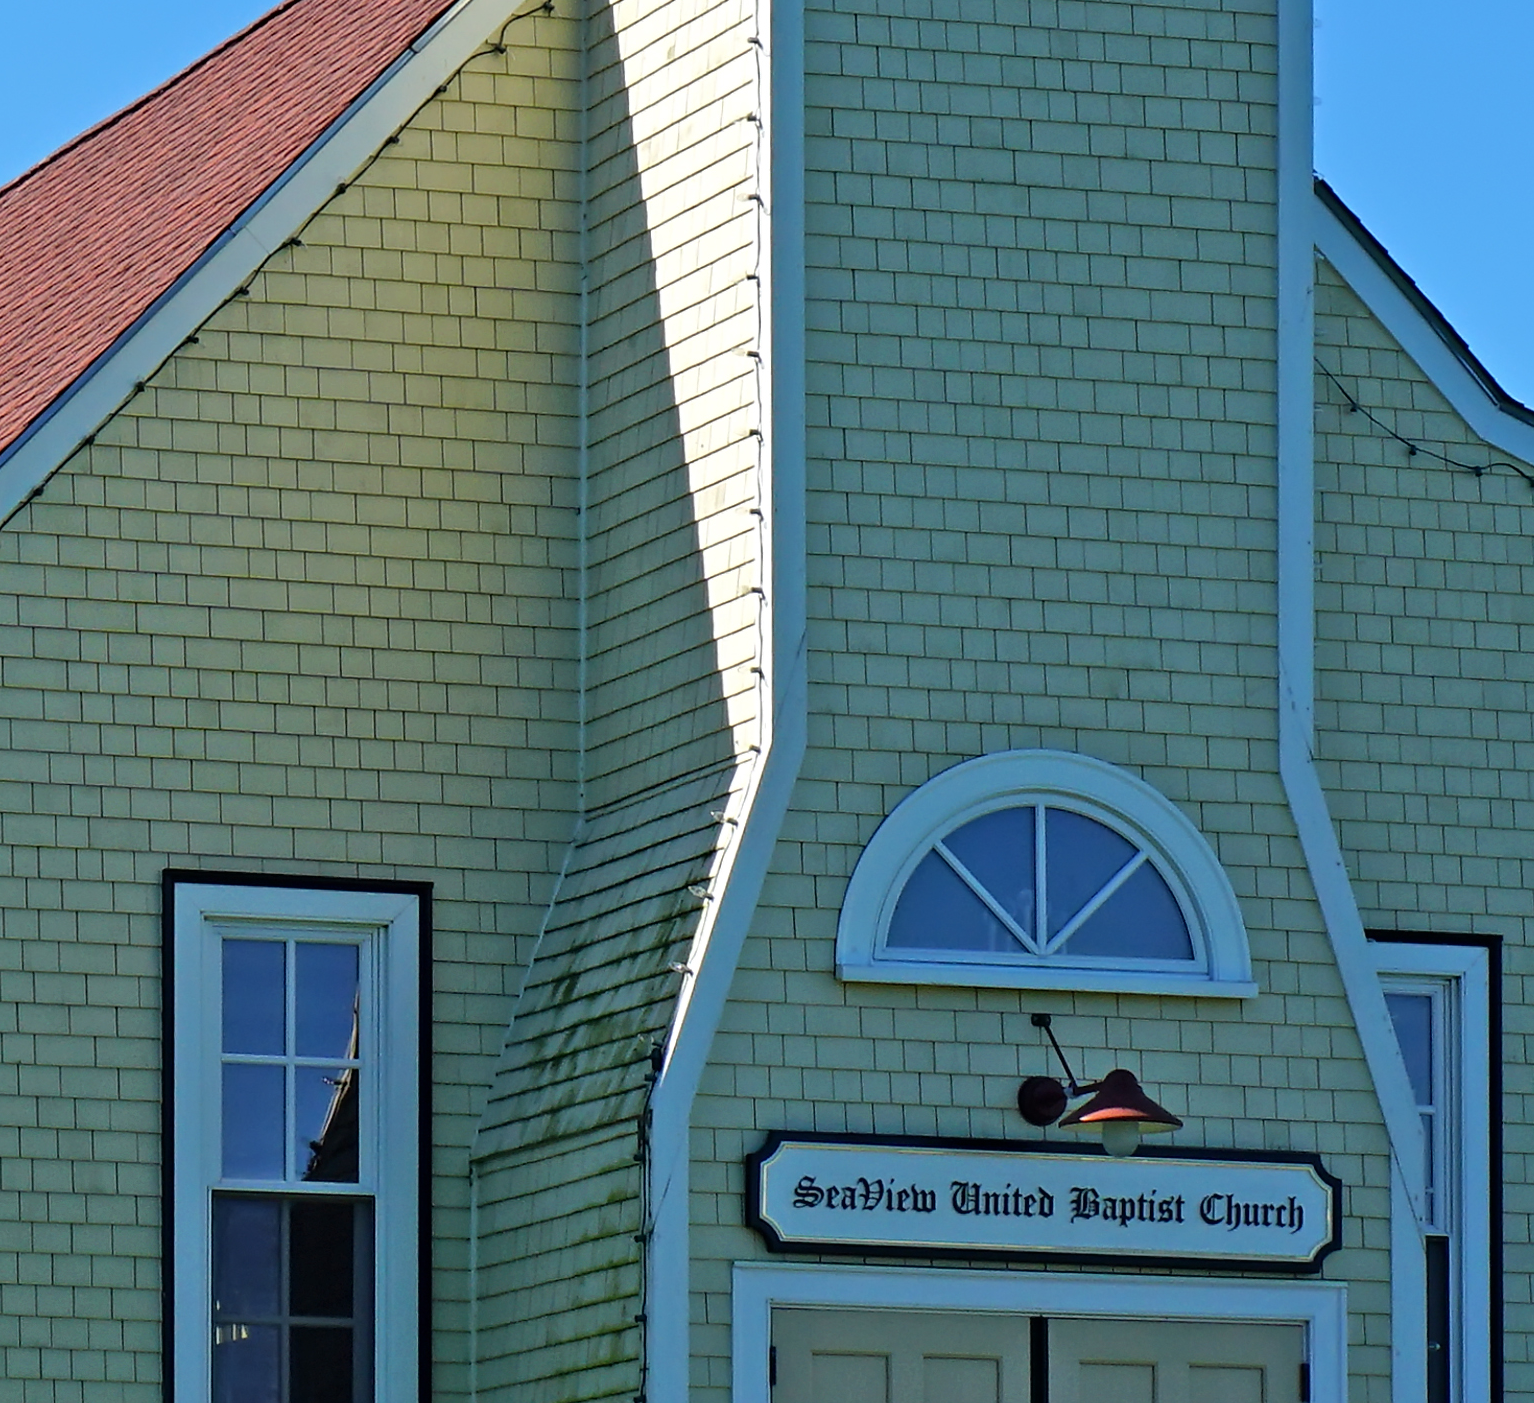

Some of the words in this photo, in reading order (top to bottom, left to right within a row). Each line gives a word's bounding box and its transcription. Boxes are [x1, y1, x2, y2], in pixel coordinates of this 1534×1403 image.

[793, 1175, 937, 1212] SeaView
[950, 1180, 1055, 1218] United
[1069, 1186, 1186, 1228] Baptist
[1199, 1192, 1304, 1235] Church
